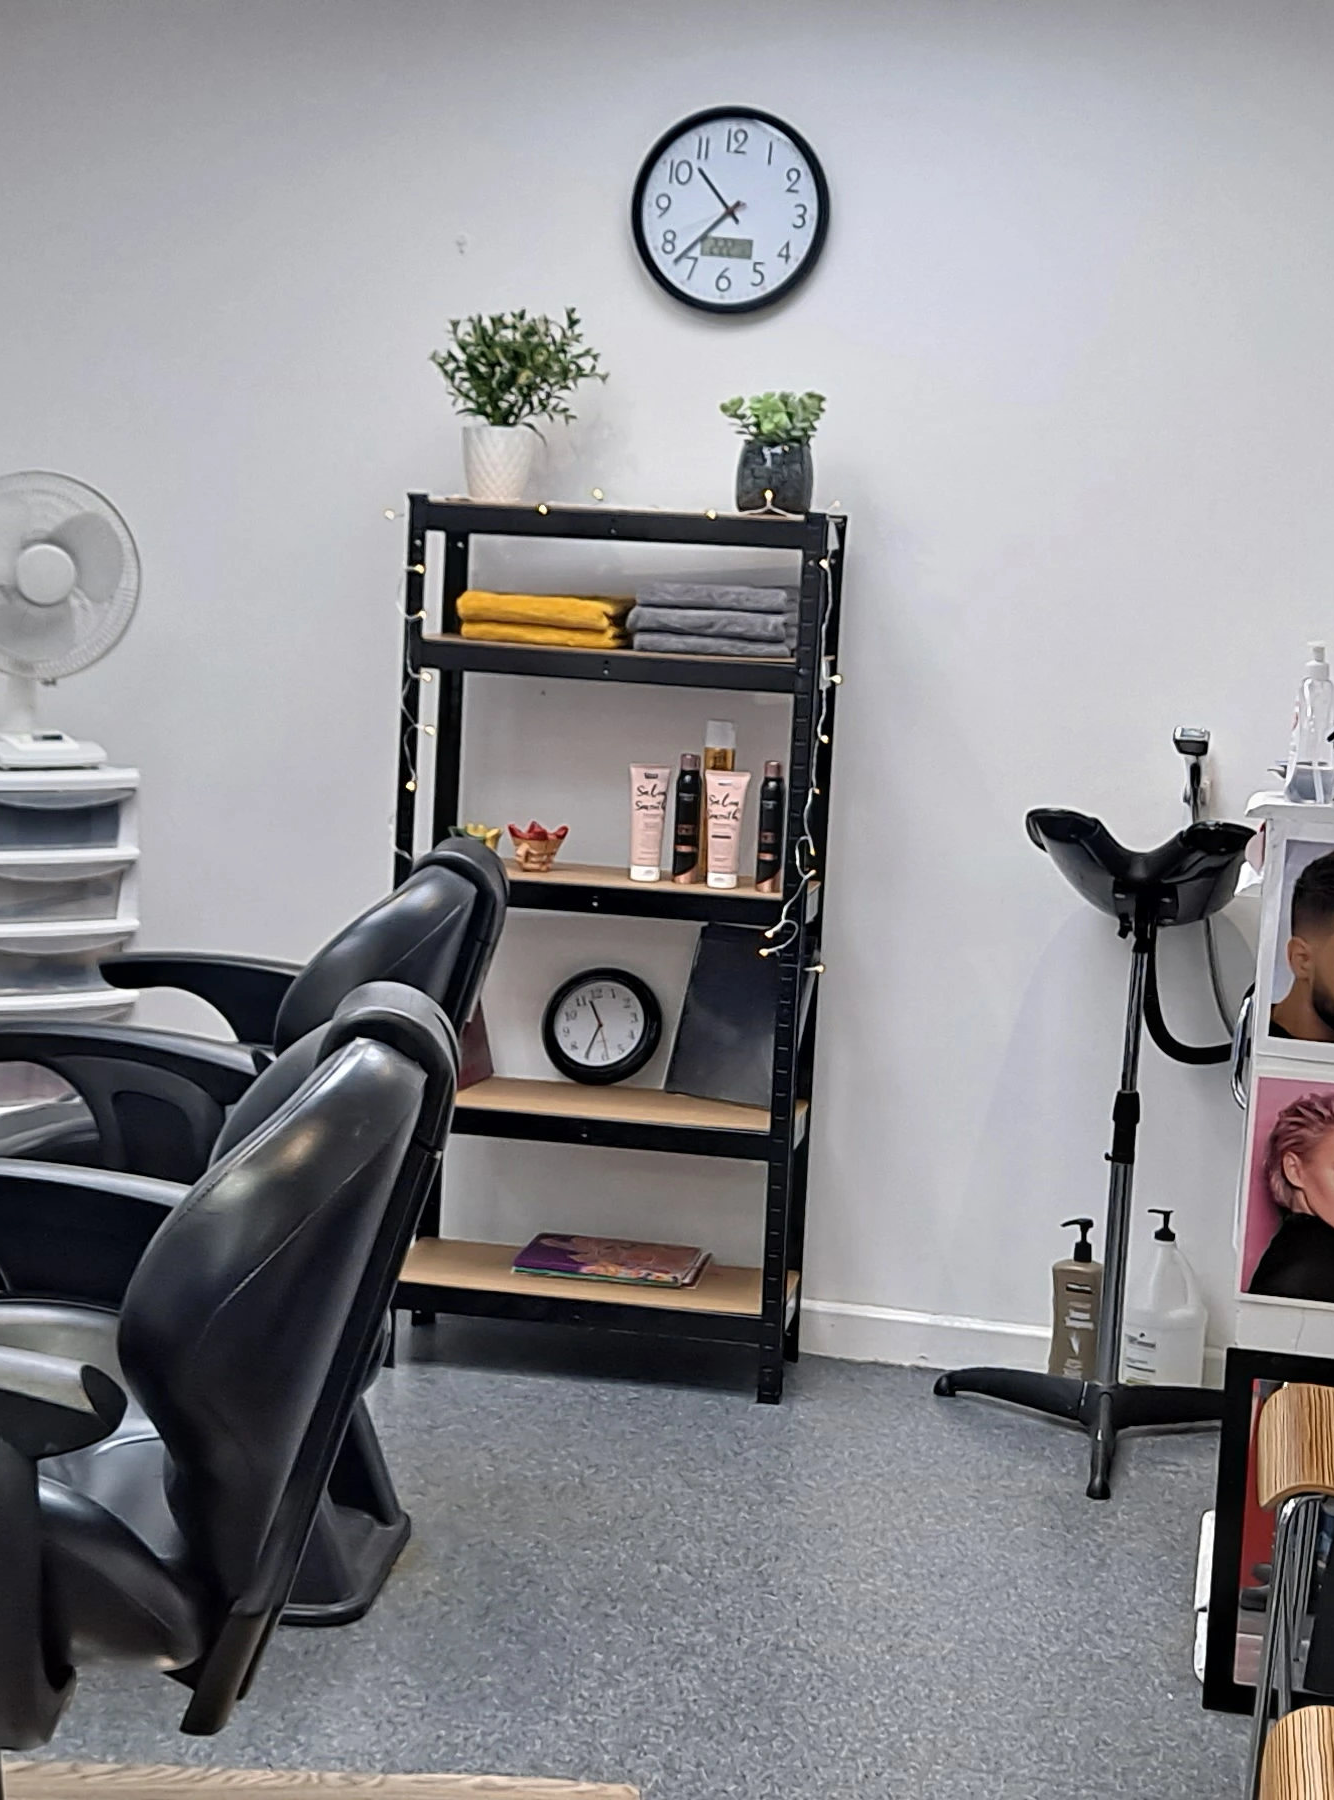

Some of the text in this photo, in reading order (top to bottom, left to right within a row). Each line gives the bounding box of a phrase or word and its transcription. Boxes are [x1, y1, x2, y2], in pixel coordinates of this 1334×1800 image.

[697, 135, 710, 160] 11
[726, 128, 748, 154] 12
[668, 159, 693, 185] 10
[785, 167, 801, 193] 2
[655, 193, 671, 218] 9
[792, 203, 807, 229] 3
[661, 229, 677, 255] 8
[777, 240, 791, 264] 4
[684, 255, 699, 281] 7
[715, 267, 731, 292] 6
[750, 261, 765, 287] 5
